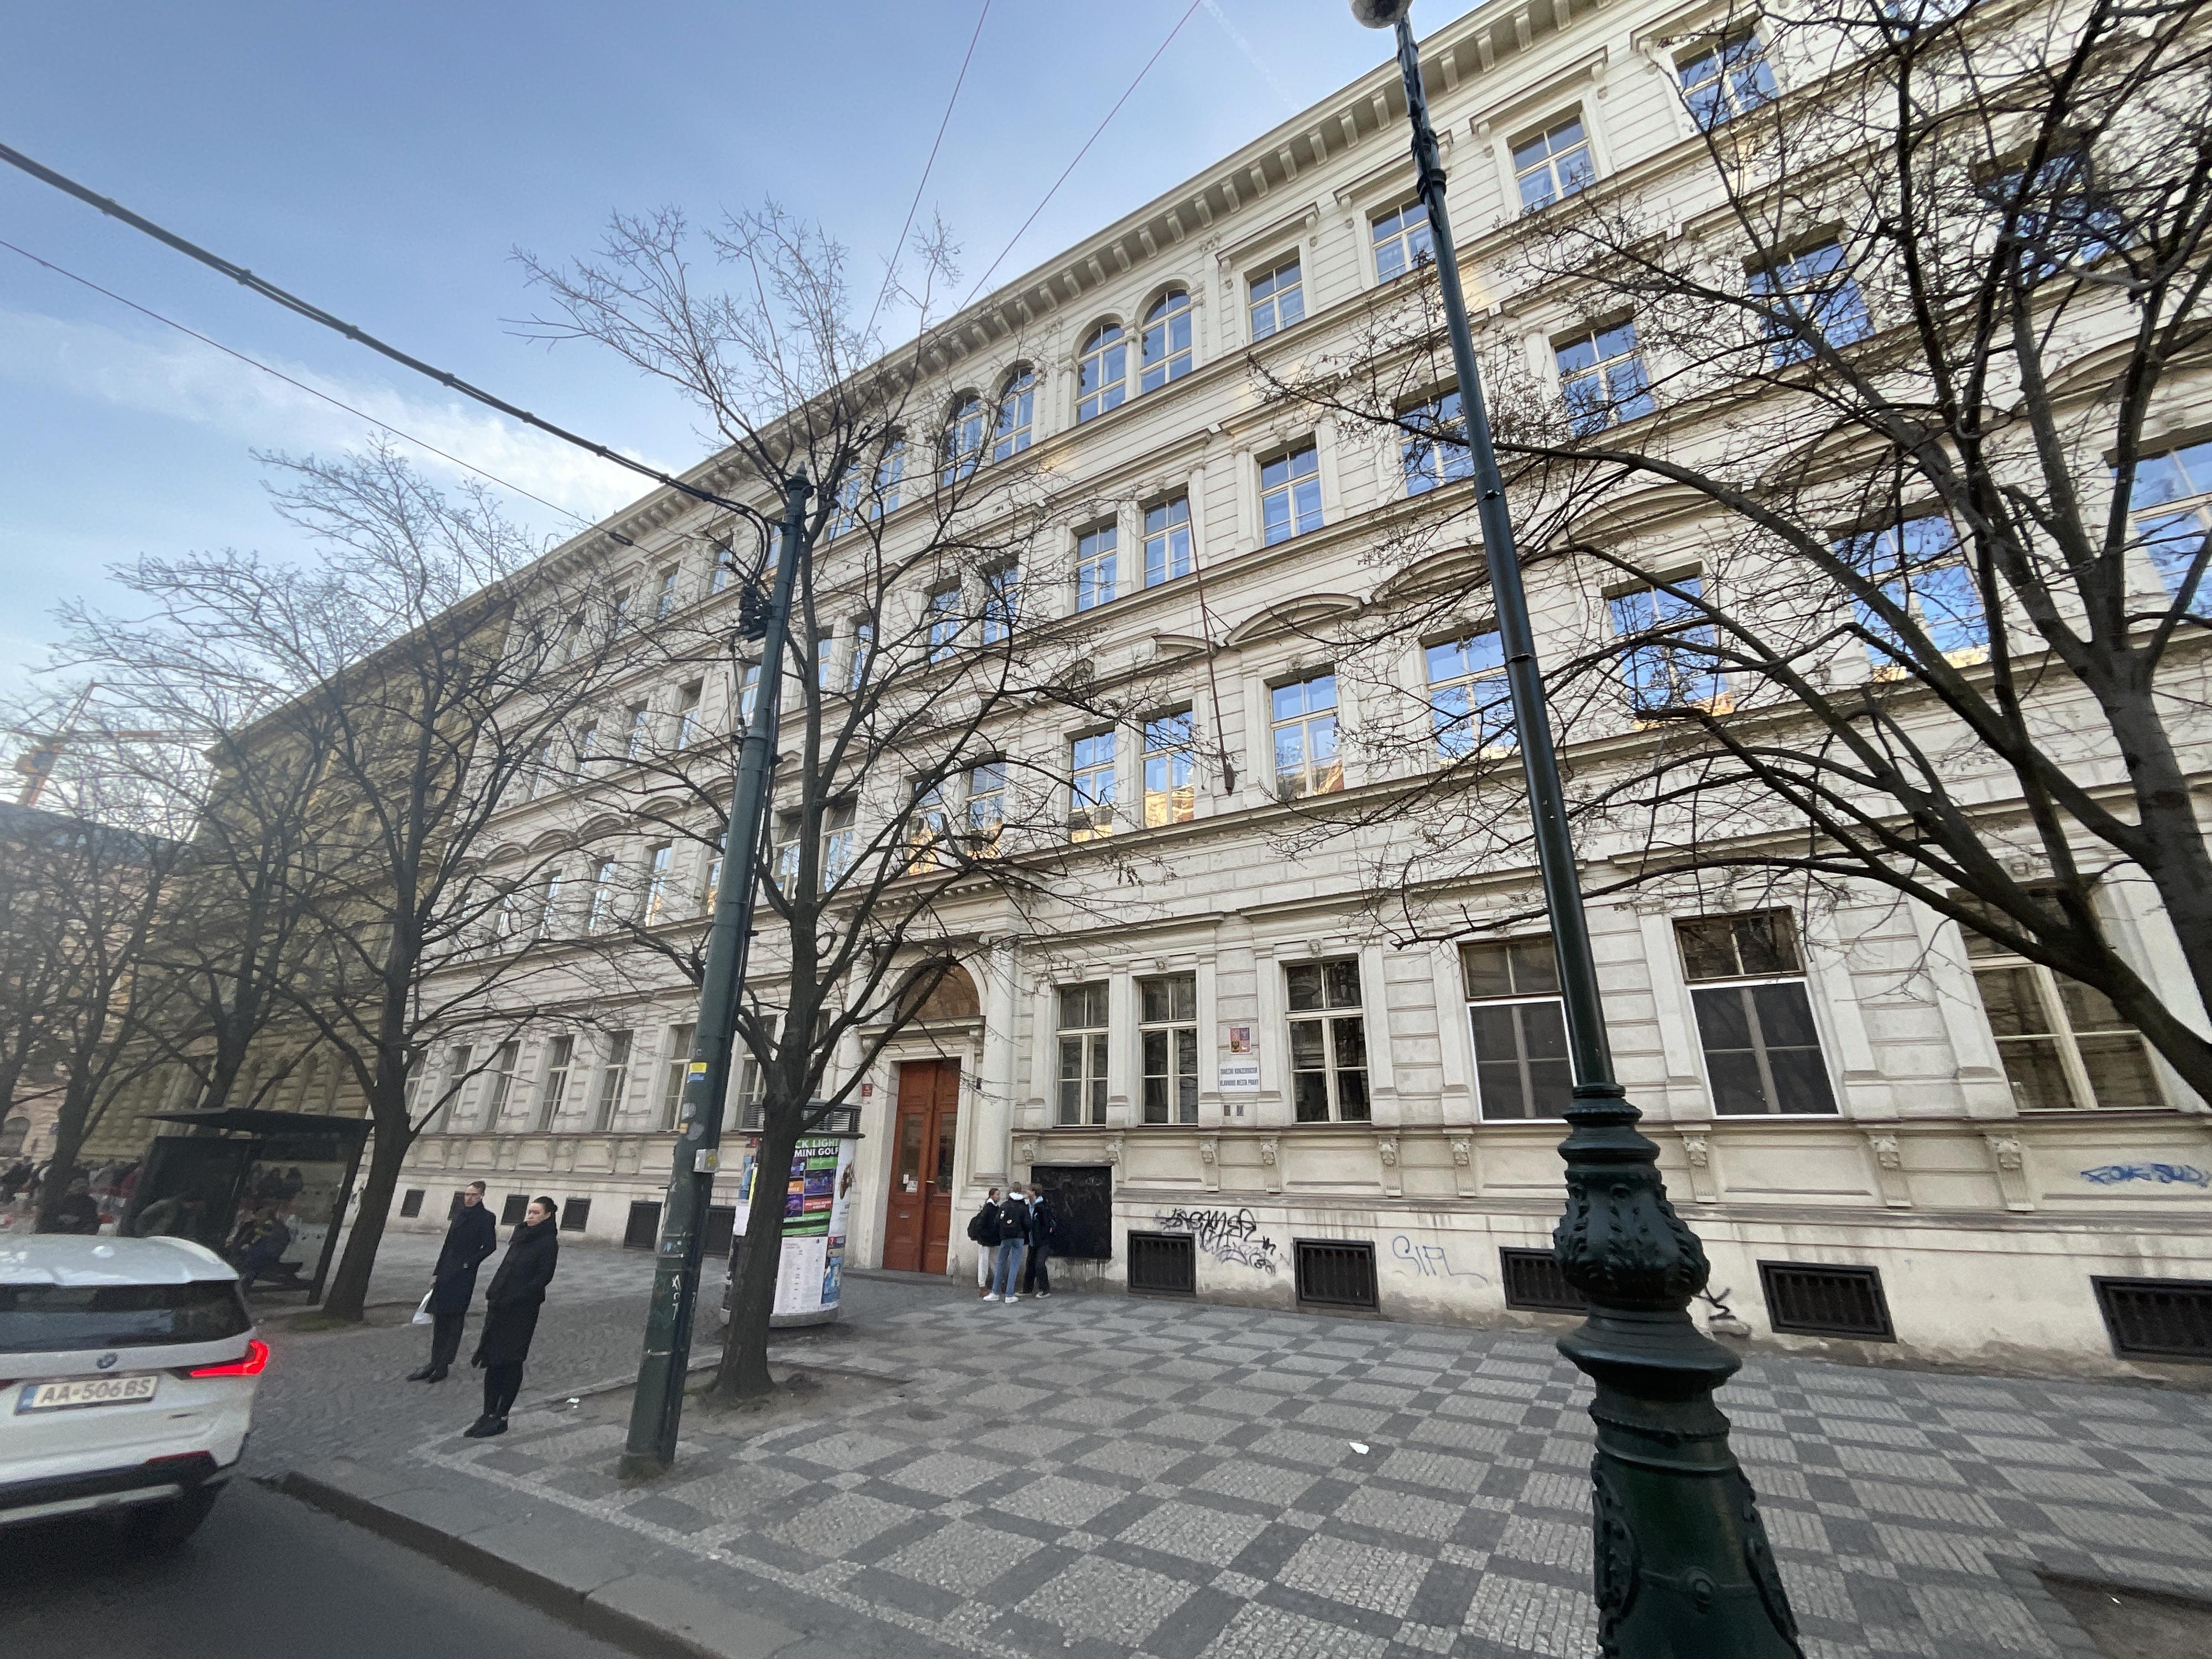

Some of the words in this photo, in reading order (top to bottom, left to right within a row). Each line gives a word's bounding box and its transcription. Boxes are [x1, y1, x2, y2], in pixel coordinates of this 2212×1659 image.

[812, 1138, 841, 1148] LIGHT
[794, 1148, 816, 1157] MINI
[818, 1147, 839, 1155] GOLF
